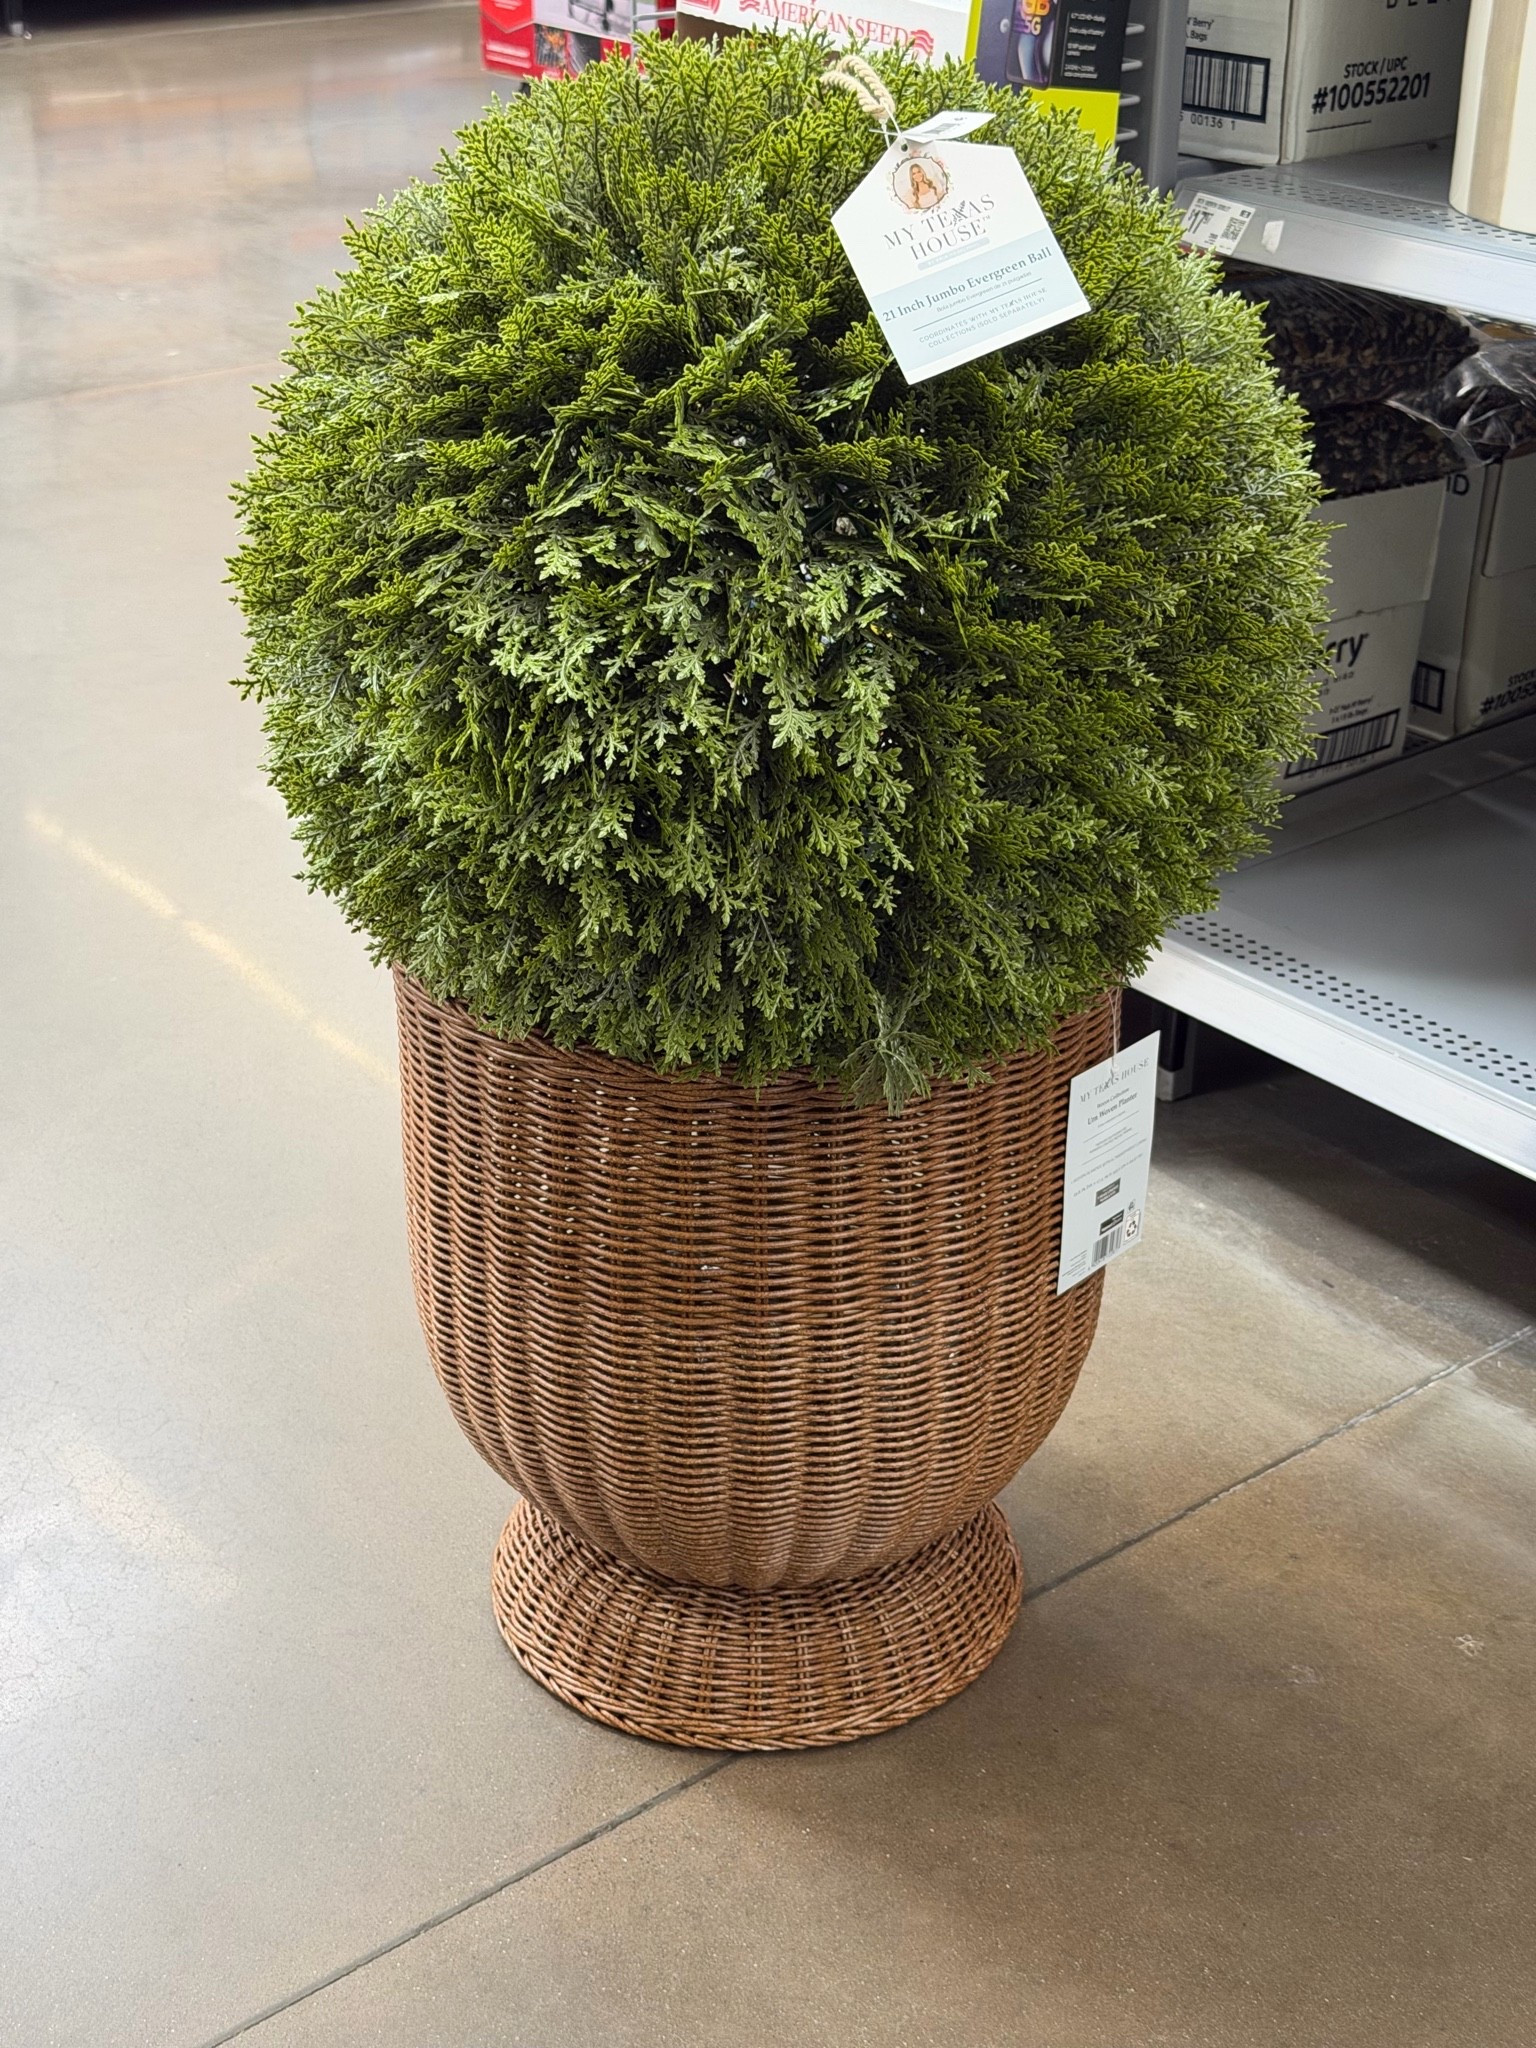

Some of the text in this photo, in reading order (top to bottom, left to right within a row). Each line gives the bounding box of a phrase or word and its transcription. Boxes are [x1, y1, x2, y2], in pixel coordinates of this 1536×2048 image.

[761, 0, 910, 47] AMERICAN SEED
[1023, 16, 1041, 36] 5G
[1311, 72, 1431, 115] #100552201
[1190, 113, 1224, 129] 00136
[884, 194, 995, 250] MY TEXAS
[882, 246, 1053, 323] 21 Inch Jumbo Evergreen Ball
[918, 286, 1048, 344] COORDINATES WITH MY TEXAS HOUSE
[928, 324, 977, 349] COLLECTIONS
[1080, 1091, 1091, 1103] MY
[1121, 1057, 1150, 1081] HOUSE
[1087, 1114, 1099, 1126] Urn
[1099, 1103, 1118, 1118] Woven
[1118, 1091, 1138, 1108] Planter
